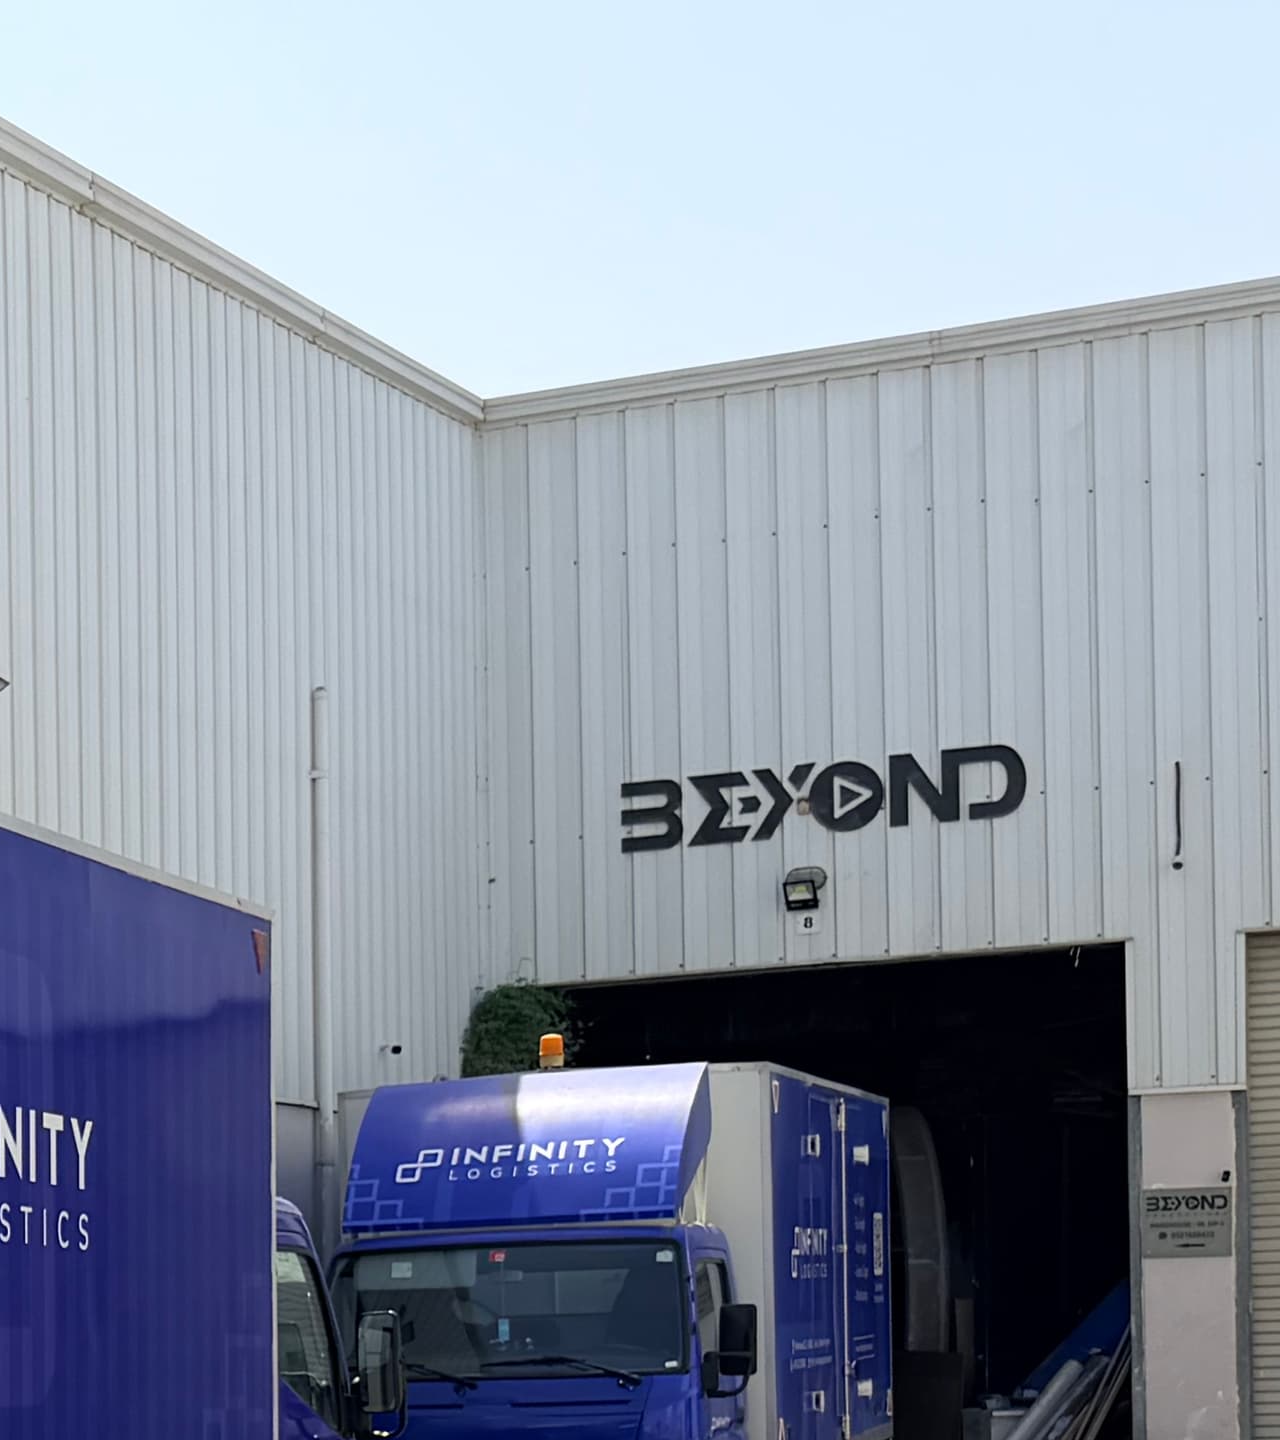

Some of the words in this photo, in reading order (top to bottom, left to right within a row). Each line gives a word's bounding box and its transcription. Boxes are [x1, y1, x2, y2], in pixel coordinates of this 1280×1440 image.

[621, 744, 1027, 852] BEYOND
[803, 916, 813, 928] 8
[450, 1137, 625, 1166] INFINITY
[448, 1159, 617, 1181] LOGISTICS
[1146, 1194, 1228, 1212] BEYOND
